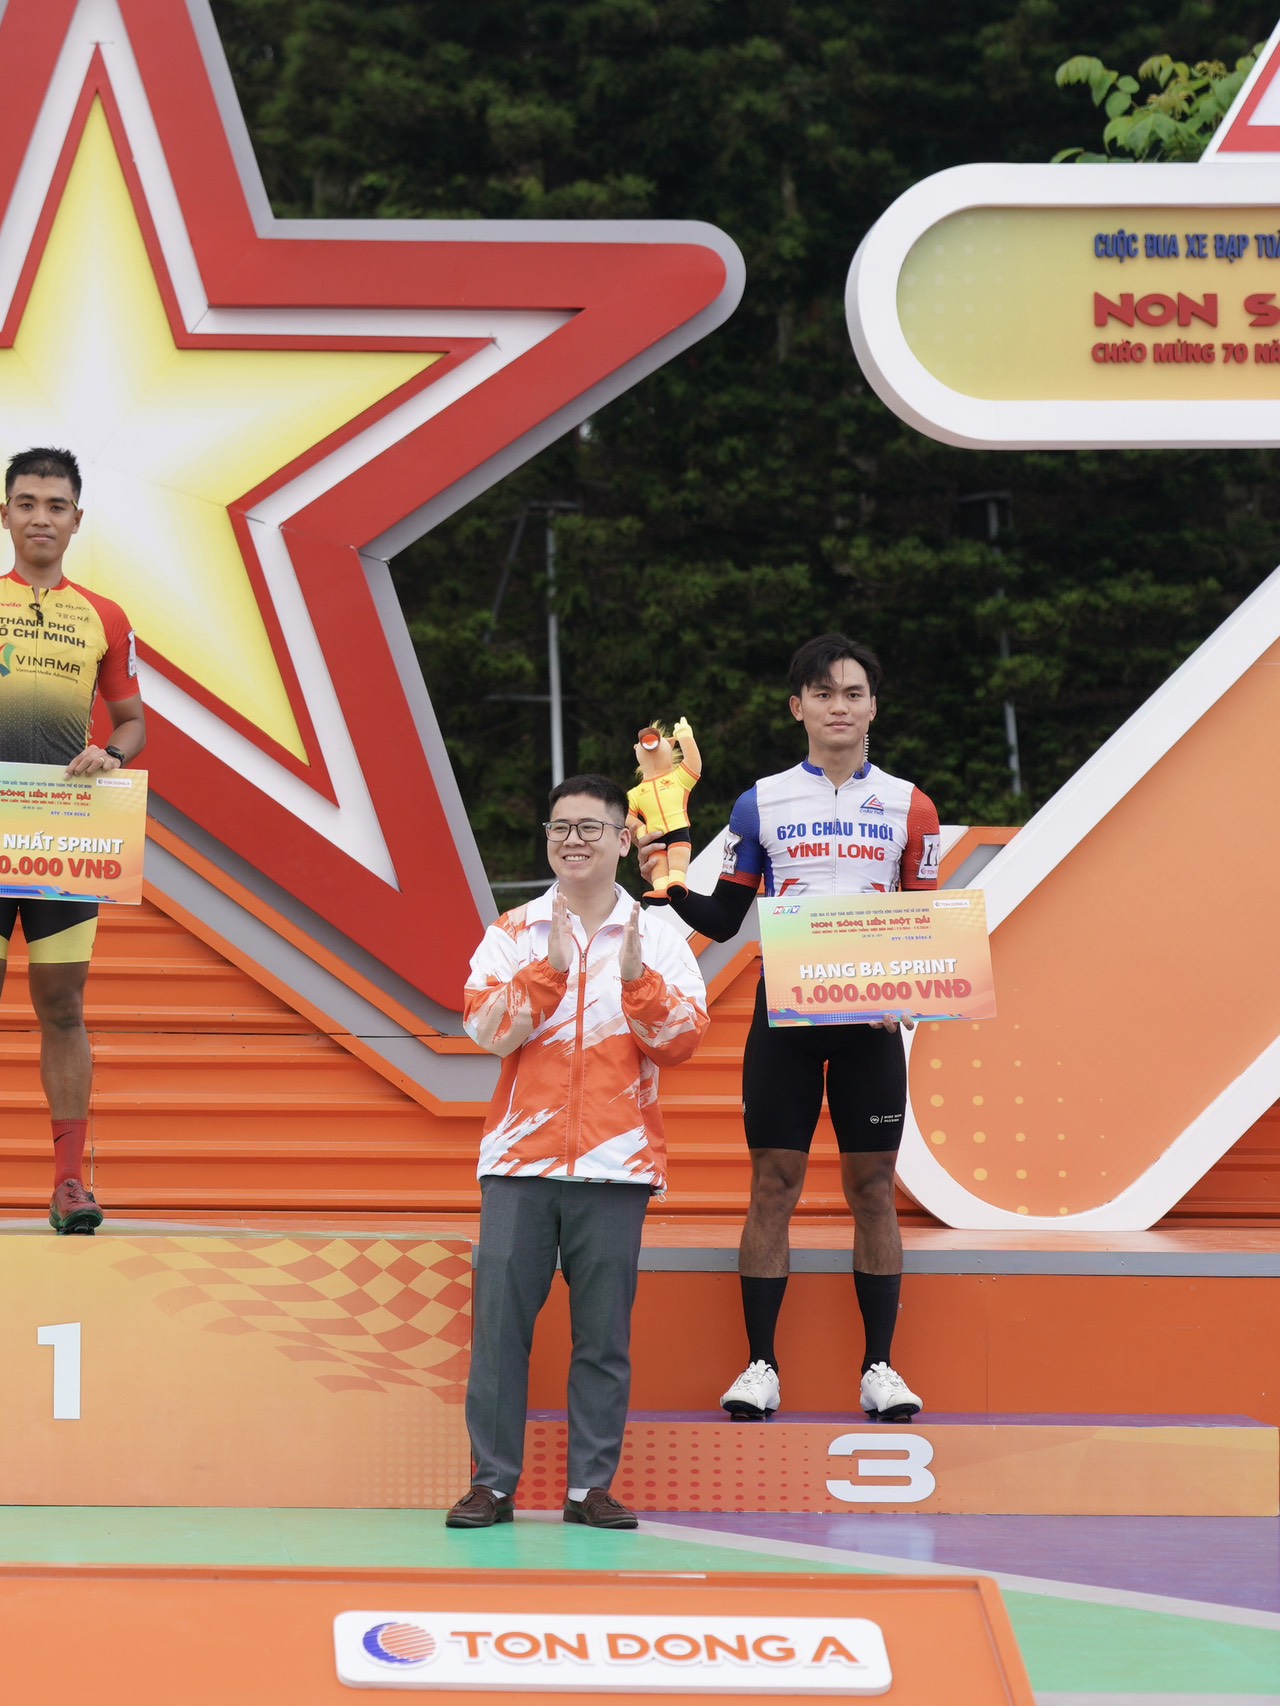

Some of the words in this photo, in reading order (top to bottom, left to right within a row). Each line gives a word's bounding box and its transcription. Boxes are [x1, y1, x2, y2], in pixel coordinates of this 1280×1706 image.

[1094, 229, 1139, 263] CUỘC
[1144, 234, 1180, 258] ĐUA
[1185, 234, 1208, 259] XE
[1214, 234, 1250, 263] ĐẠP
[1254, 230, 1280, 258] TO
[1094, 292, 1218, 328] NON
[1221, 343, 1249, 364] 70
[13, 627, 39, 639] CHÍ
[43, 631, 86, 649] MINH
[48, 621, 76, 633] PHỐ
[15, 654, 81, 675] VINAMA
[777, 823, 807, 841] 620
[812, 818, 853, 837] CHÂU
[3, 830, 54, 851] NHẤT
[57, 836, 124, 854] SPRINT
[786, 841, 830, 859] VĨNH
[838, 843, 885, 861] LONG
[68, 857, 122, 879] VNĐ
[773, 905, 800, 914] HTV
[811, 921, 833, 929] NON
[799, 963, 856, 983] HẠNG
[859, 961, 886, 977] BA
[889, 958, 957, 976] SPRINT
[791, 981, 912, 1004] 1.000.000
[915, 978, 971, 999] VNĐ
[37, 1322, 81, 1420] 1
[826, 1433, 936, 1503] 3
[450, 1630, 591, 1662] TON
[605, 1632, 797, 1663] DONG
[811, 1635, 860, 1664] A
